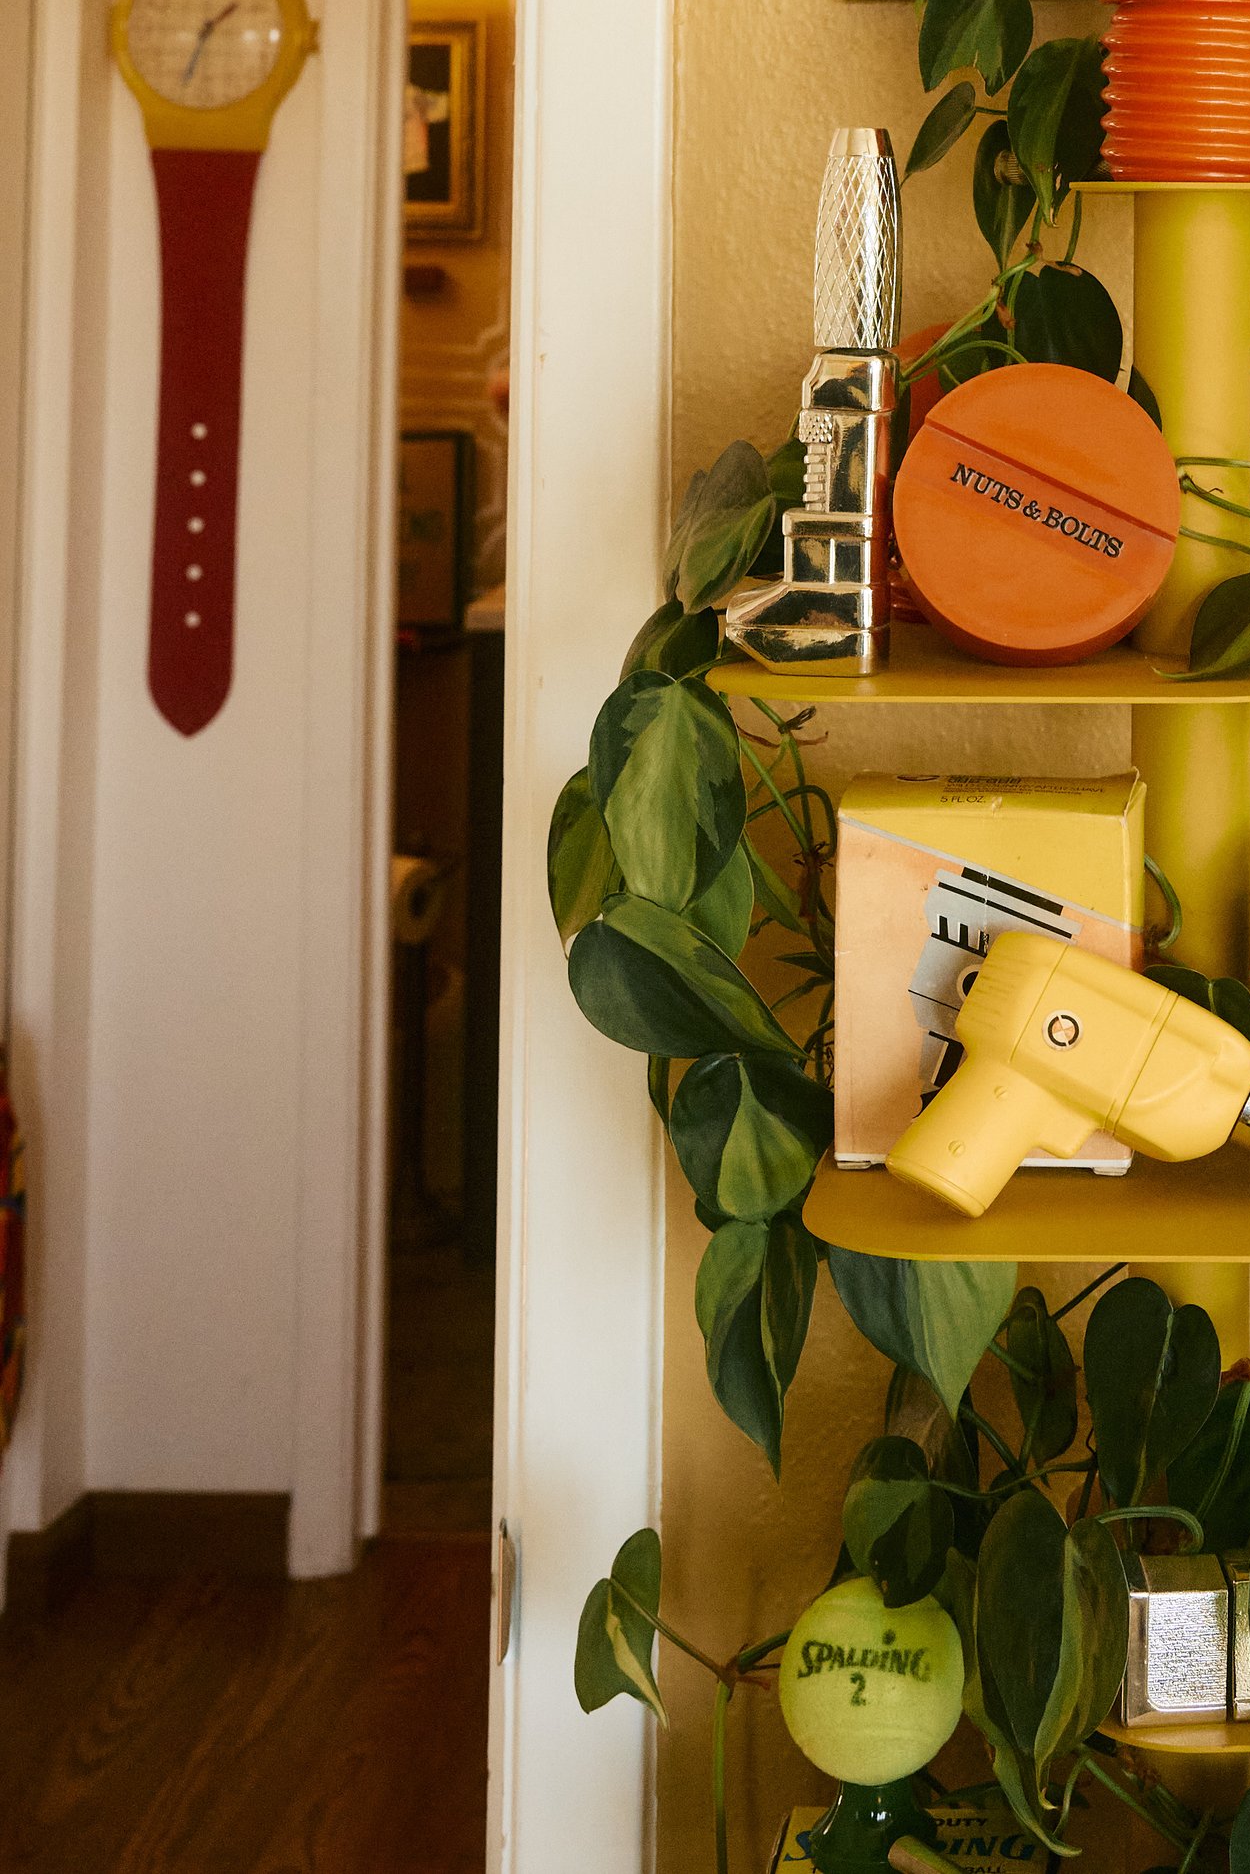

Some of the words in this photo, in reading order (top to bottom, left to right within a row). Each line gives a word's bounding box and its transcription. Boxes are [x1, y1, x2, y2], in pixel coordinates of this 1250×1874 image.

[950, 462, 1025, 510] NUTS
[1022, 500, 1041, 521] &
[1042, 506, 1124, 559] BOLTS
[797, 1629, 931, 1683] SPALDING
[850, 1671, 866, 1706] 2
